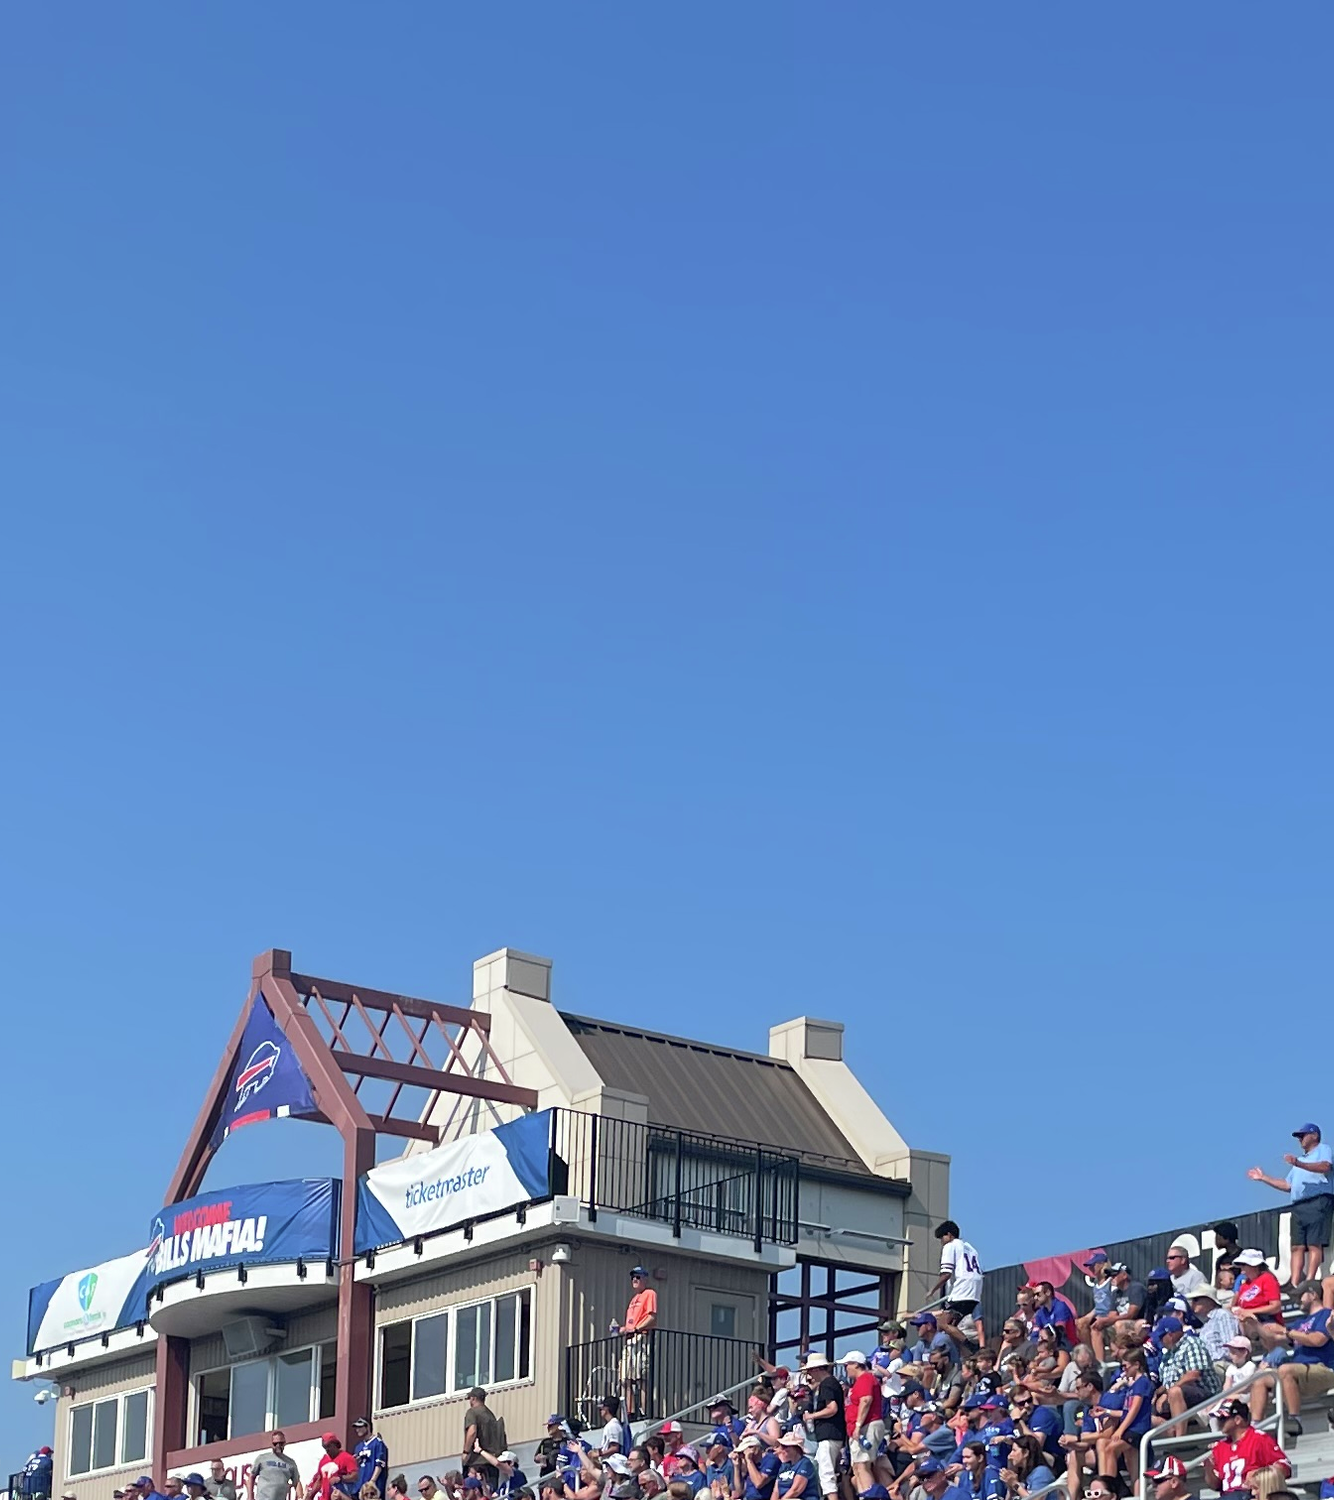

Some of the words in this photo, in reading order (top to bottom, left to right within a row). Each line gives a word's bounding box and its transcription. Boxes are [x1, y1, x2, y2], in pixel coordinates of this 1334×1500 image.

[405, 1164, 490, 1209] ticketmaster
[174, 1201, 233, 1236] WELCOME
[155, 1230, 191, 1276] BILLS
[190, 1215, 268, 1263] MAFIA!
[963, 1252, 982, 1275] 14
[1222, 1457, 1247, 1492] 17
